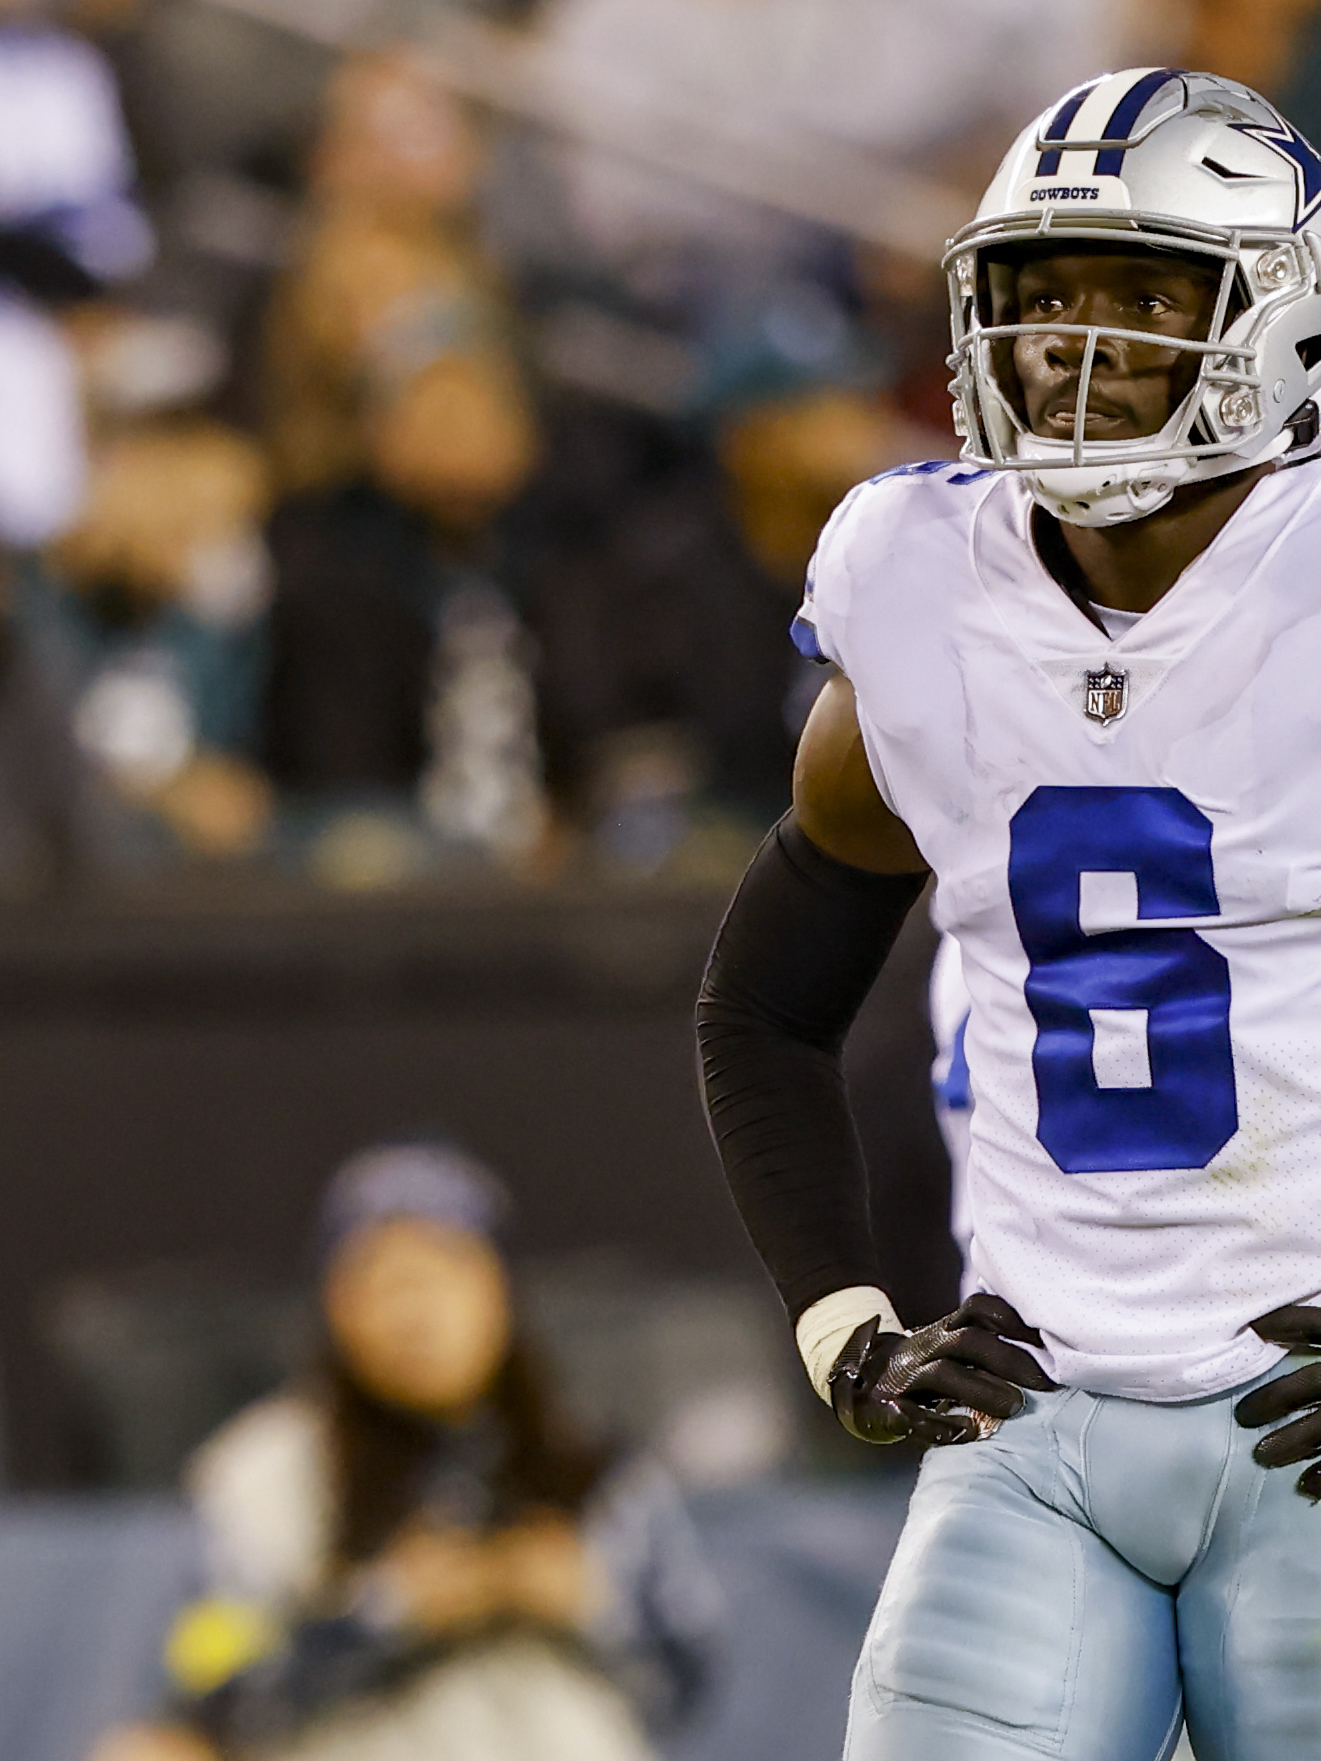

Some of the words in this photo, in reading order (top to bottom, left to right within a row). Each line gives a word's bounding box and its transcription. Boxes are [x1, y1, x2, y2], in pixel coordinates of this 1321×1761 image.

[1030, 187, 1100, 202] COWBOYS
[1090, 691, 1120, 714] NFL
[1008, 785, 1239, 1174] 6
